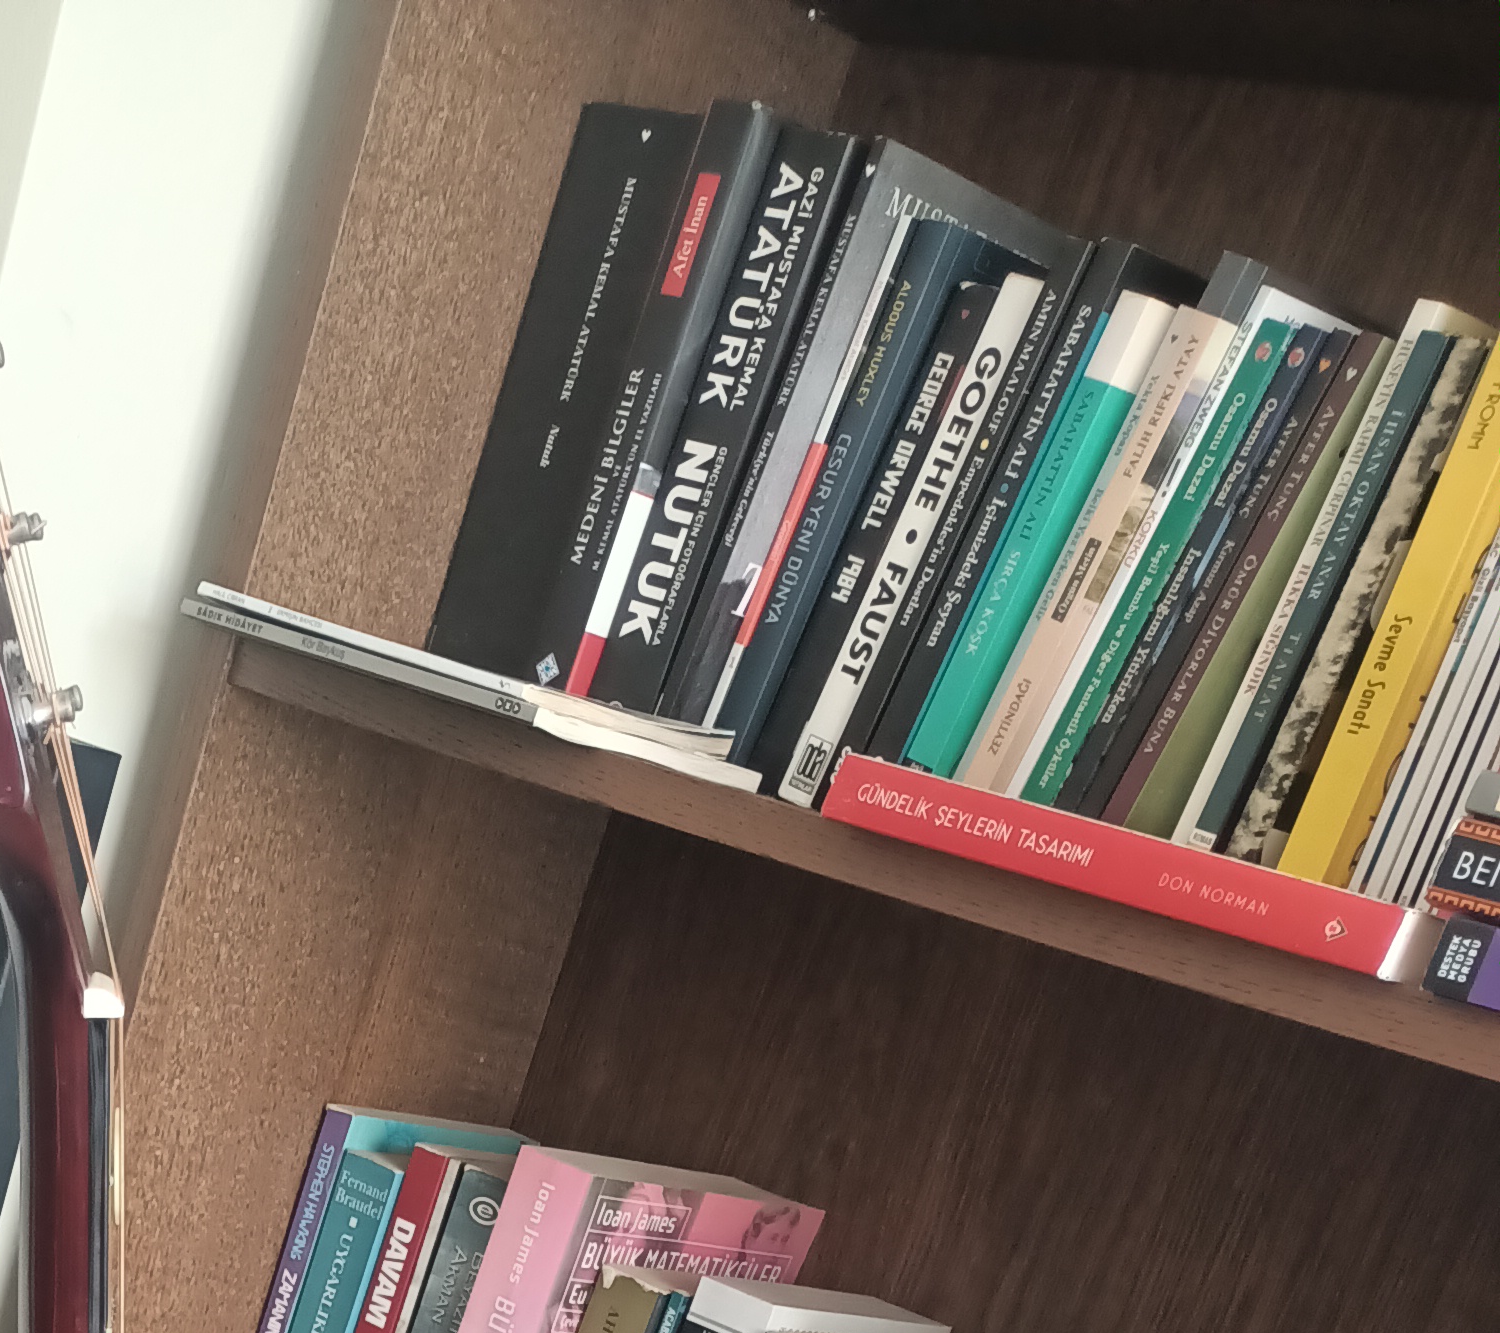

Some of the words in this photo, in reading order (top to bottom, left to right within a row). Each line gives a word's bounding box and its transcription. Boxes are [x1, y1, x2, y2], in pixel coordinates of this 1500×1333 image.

[604, 177, 637, 258] MUSTAFA
[797, 166, 825, 219] GAZİ
[672, 240, 691, 280] Afet
[683, 195, 708, 236] İnan
[825, 213, 857, 285] MUSTAFA
[584, 262, 610, 321] KEMAL
[699, 161, 804, 409] ATATÜRK
[766, 223, 805, 331] MUSTAFA
[806, 285, 829, 338] KEMAL
[881, 279, 913, 343] ALDOUS
[560, 325, 591, 402] ATATÜRK
[729, 336, 767, 412] KEMAL
[776, 339, 809, 407] ATATÜRK
[854, 341, 885, 408] HUXLEY
[1026, 304, 1094, 443] SABAHATTİN
[1147, 379, 1172, 429] RIFKI
[1171, 333, 1200, 381] ATAY
[1213, 321, 1253, 392] STEFAN
[638, 372, 663, 428] YAZILARI
[904, 351, 955, 436] GEORGE
[987, 341, 1034, 438] MAALOUF
[539, 424, 560, 469] Nutuk
[914, 346, 1002, 513] GOETHE
[1035, 389, 1096, 509] SABAHATTİN
[1209, 392, 1247, 452] Osamu
[1298, 405, 1336, 466] AYFER
[1366, 408, 1408, 476] İHSAN
[570, 474, 608, 566] MEDENİ
[600, 367, 645, 478] BİLGİLER
[815, 432, 852, 501] CESUR
[860, 437, 916, 531] ORWELL
[1003, 442, 1029, 481] ALİ
[1183, 453, 1215, 503] Dazai
[1213, 459, 1249, 509] Dazai
[1267, 470, 1307, 523] TUNÇ
[1335, 480, 1371, 547] OKTAY
[618, 438, 718, 646] NUTUK
[952, 496, 1008, 598] İçimizdeki
[1122, 509, 1158, 569] KORKU
[763, 554, 803, 625] DÜNYA
[830, 553, 865, 604] 1984
[988, 550, 1023, 604] SIRÇA
[1218, 554, 1259, 612] ÖMÜR
[1275, 562, 1313, 622] HAKKA
[1307, 549, 1338, 603] ANAR
[840, 560, 909, 686] FAUST
[925, 590, 963, 649] Şeytan
[1372, 613, 1414, 673] Sevme
[987, 677, 1032, 756] ZEYTİNDAĞI
[1143, 706, 1177, 755] BUNA
[1346, 679, 1387, 736] Sanatı
[856, 781, 930, 822] GÜNDELİK
[934, 804, 1014, 845] ŞEYLERİN
[1017, 826, 1095, 869] TASARIMI
[1157, 871, 1195, 896] DON
[1199, 884, 1271, 917] NORMAN
[1437, 934, 1463, 979] DESTEK
[1446, 938, 1473, 982] MEDYA
[1457, 939, 1483, 984] GRUBU
[309, 1143, 335, 1203] STEPHEN
[340, 1169, 389, 1204] Fernand
[530, 1181, 556, 1225] Ioan
[290, 1202, 318, 1261] HAWKING
[334, 1186, 384, 1221] Braudel
[596, 1201, 632, 1233] Ioan
[631, 1206, 678, 1234] James
[365, 1217, 417, 1330] DAVAM
[431, 1244, 468, 1324] AKMAN
[509, 1225, 540, 1285] James
